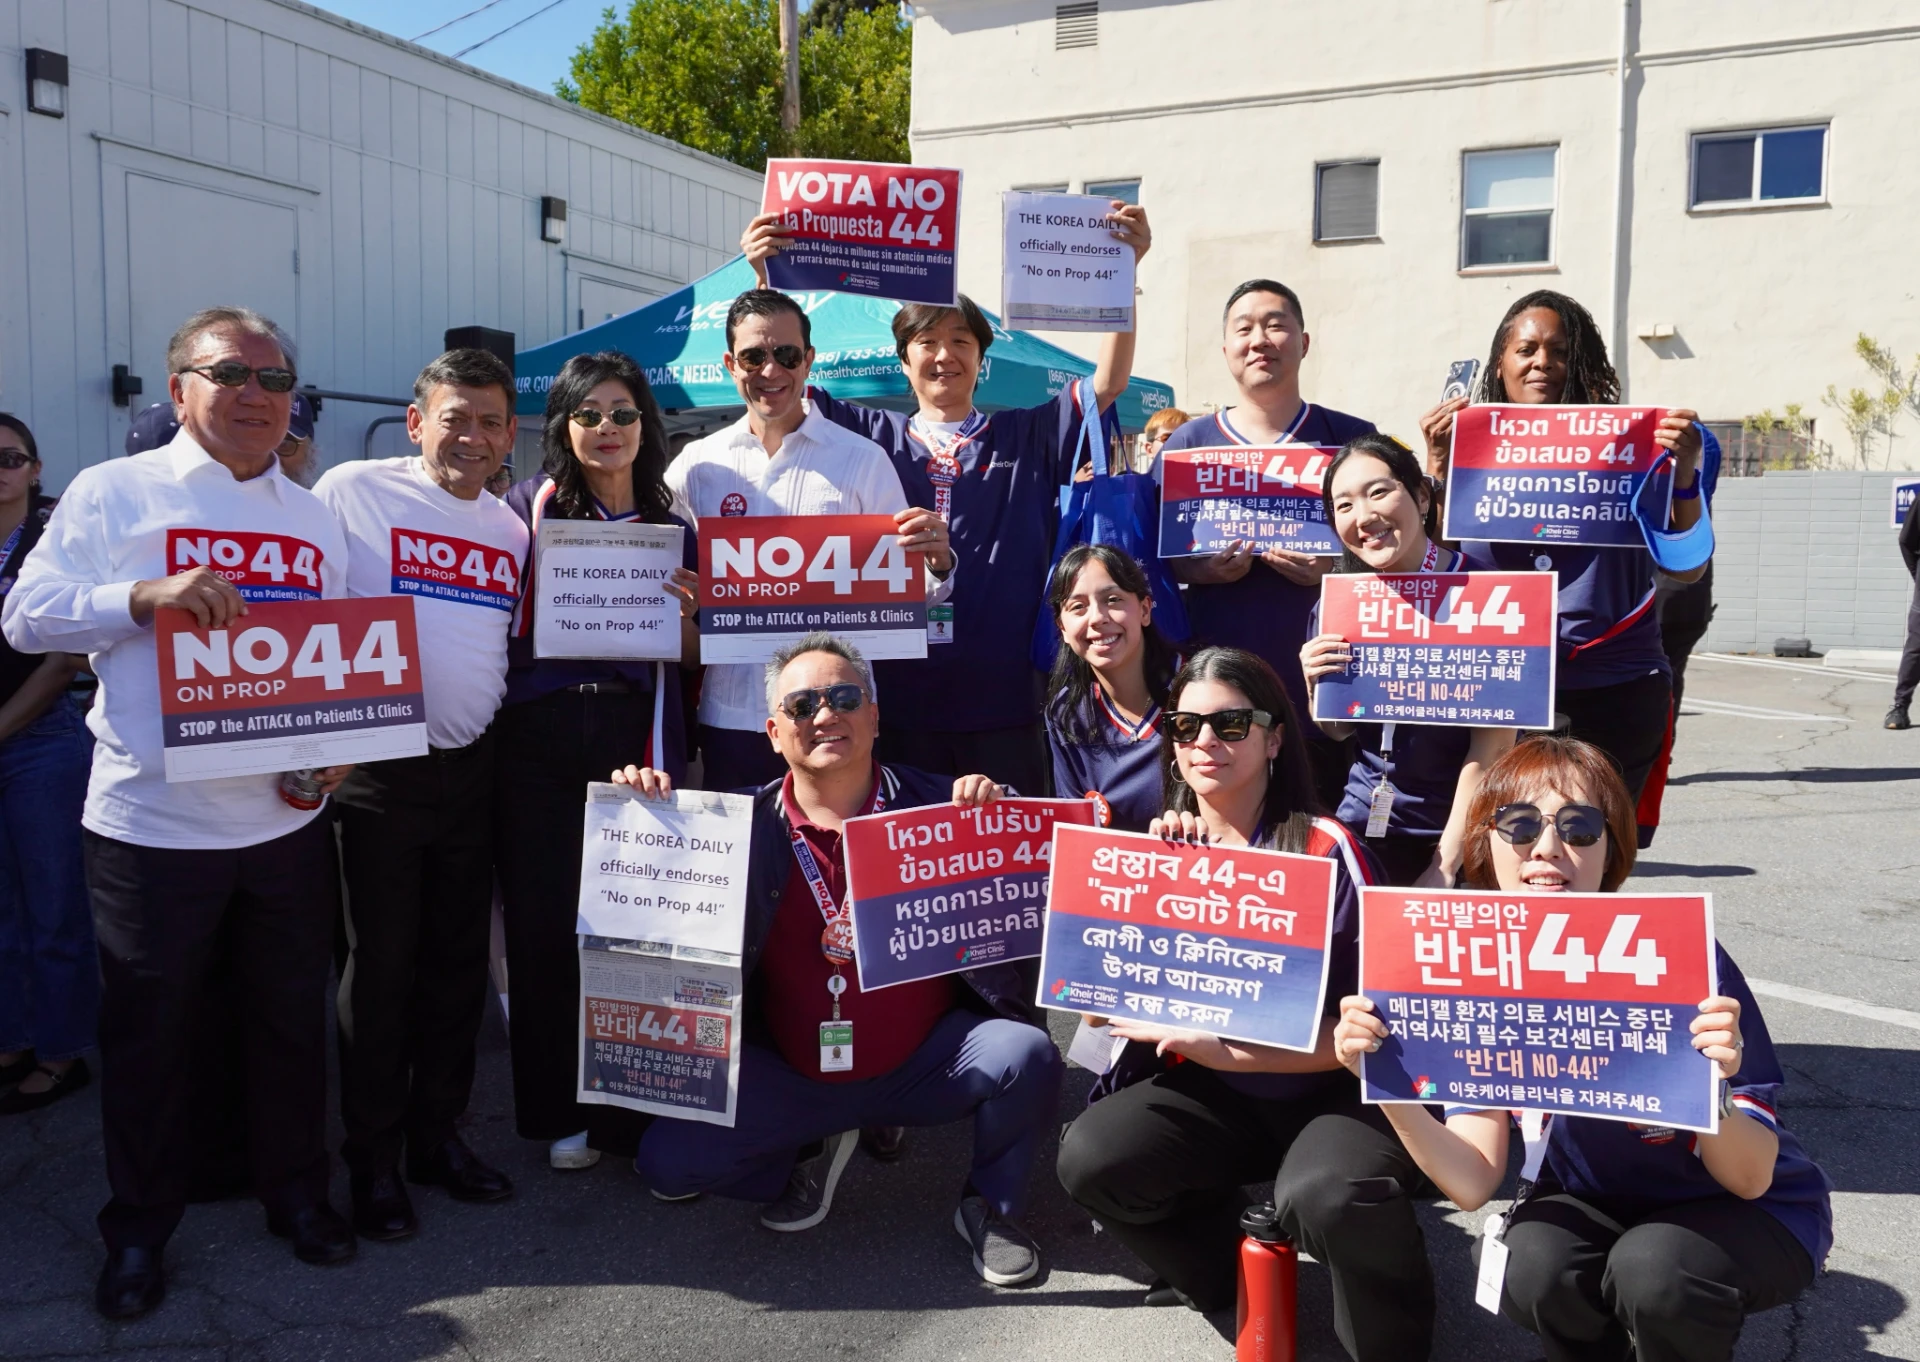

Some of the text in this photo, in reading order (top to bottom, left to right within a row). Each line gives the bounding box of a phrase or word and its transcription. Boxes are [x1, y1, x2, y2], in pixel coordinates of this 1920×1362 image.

[777, 171, 945, 212] VOTA NO
[784, 207, 942, 246] la Propuesta 44
[1019, 213, 1042, 225] THE
[1046, 214, 1084, 228] KOREA
[811, 242, 952, 265] 44 dejará millones sin atención médica
[1020, 239, 1121, 256] officially endorses
[797, 254, 928, 276] cerrará centros salud comunitarios
[1022, 264, 1118, 282] “No on Prop 44!”
[683, 363, 723, 384] NEEDS
[1490, 410, 1643, 437] โหวต "ไม่รับ"
[936, 457, 955, 466] NO
[1189, 451, 1264, 466] 주민발의안
[1495, 440, 1635, 465] ข้อเสนอ 44
[940, 465, 957, 476] 44
[1196, 455, 1327, 494] 반대 44
[1487, 471, 1632, 498] หยุดการโจมตี
[726, 496, 740, 504] NO
[1179, 498, 1311, 512] 메디캘 환자 의료 서비스
[1176, 510, 1307, 523] 지역사회 필수 보건센터
[1215, 521, 1304, 537] “반대 NO-44!”
[1285, 541, 1332, 550] 지켜주세요
[175, 537, 318, 587] NO 44
[399, 535, 516, 593] NO 44
[399, 564, 457, 581] ON PROP
[552, 567, 669, 581] THE KOREA DAILY
[711, 534, 913, 596] NO 44
[253, 589, 264, 598] on
[265, 589, 297, 599] Patients
[399, 580, 496, 604] STOP the ATTACK on Patients
[711, 582, 801, 599] ON PROP
[1352, 579, 1438, 598] 주민발의안
[552, 593, 666, 609] officially endorses
[1358, 585, 1526, 639] 반대 44
[555, 618, 664, 634] “No on Prop 44!”
[712, 608, 914, 628] STOP the ATTACK on Patients & Clinics
[172, 619, 408, 691] NO 44
[1382, 647, 1411, 663] 환자
[1415, 648, 1444, 663] 의료
[1447, 648, 1492, 664] 서비스
[1495, 649, 1526, 665] 중단
[1396, 663, 1424, 679] 필수
[1427, 664, 1487, 681] 보건센터
[1491, 664, 1521, 681] 폐쇄
[176, 679, 287, 704] ON PROP
[1379, 680, 1482, 702] “반대 NO-44!”
[179, 703, 413, 738] STOP the ATTACK on Patients & Clinics
[1374, 704, 1515, 721] 이웃케어클리닉을 지켜주세요
[884, 820, 953, 851] โหวต
[960, 804, 1055, 836] "ไม่รับ"
[602, 828, 733, 855] THE KOREA DAILY
[600, 859, 729, 886] officially endorses
[899, 841, 1051, 884] ข้อเสนอ 44
[1092, 846, 1286, 895] প্রস্তাব 44-এ
[815, 881, 828, 899] NO
[601, 890, 725, 915] “No on Prop 44!”
[820, 899, 838, 920] 44
[1088, 877, 1297, 936] "না" ভোট দিন
[1402, 899, 1529, 931] 주민발의안
[889, 907, 1046, 960] ผู้ป่วยและคลิ
[1082, 925, 1286, 974] রোগী ও ক্লিনিকের
[1414, 913, 1667, 991] 반대 44
[1102, 952, 1263, 1001] উপর আক্রমণ
[1069, 987, 1093, 999] Kheir
[1093, 991, 1118, 1004] Clinic
[589, 1000, 640, 1017] 주민발의안
[1124, 990, 1164, 1016] বন্ধ
[1168, 999, 1232, 1027] করুন
[1389, 997, 1673, 1032] 메디캘 환자 의료 서비스 중단
[593, 1011, 688, 1045] 반대 44
[1389, 1019, 1668, 1055] 지역사회 필수 보건센터 폐쇄
[594, 1052, 690, 1076] 지역사회 필수 보건센터
[595, 1041, 715, 1070] 메디캘 환자 의료 서비스 중단
[1454, 1048, 1610, 1081] “반대 NO-44!”
[609, 1081, 707, 1105] 이웃케어클리닉을 지켜주세요
[654, 1073, 687, 1090] NO-44!”
[1449, 1081, 1662, 1113] 이웃케어클리닉을 지켜주세요
